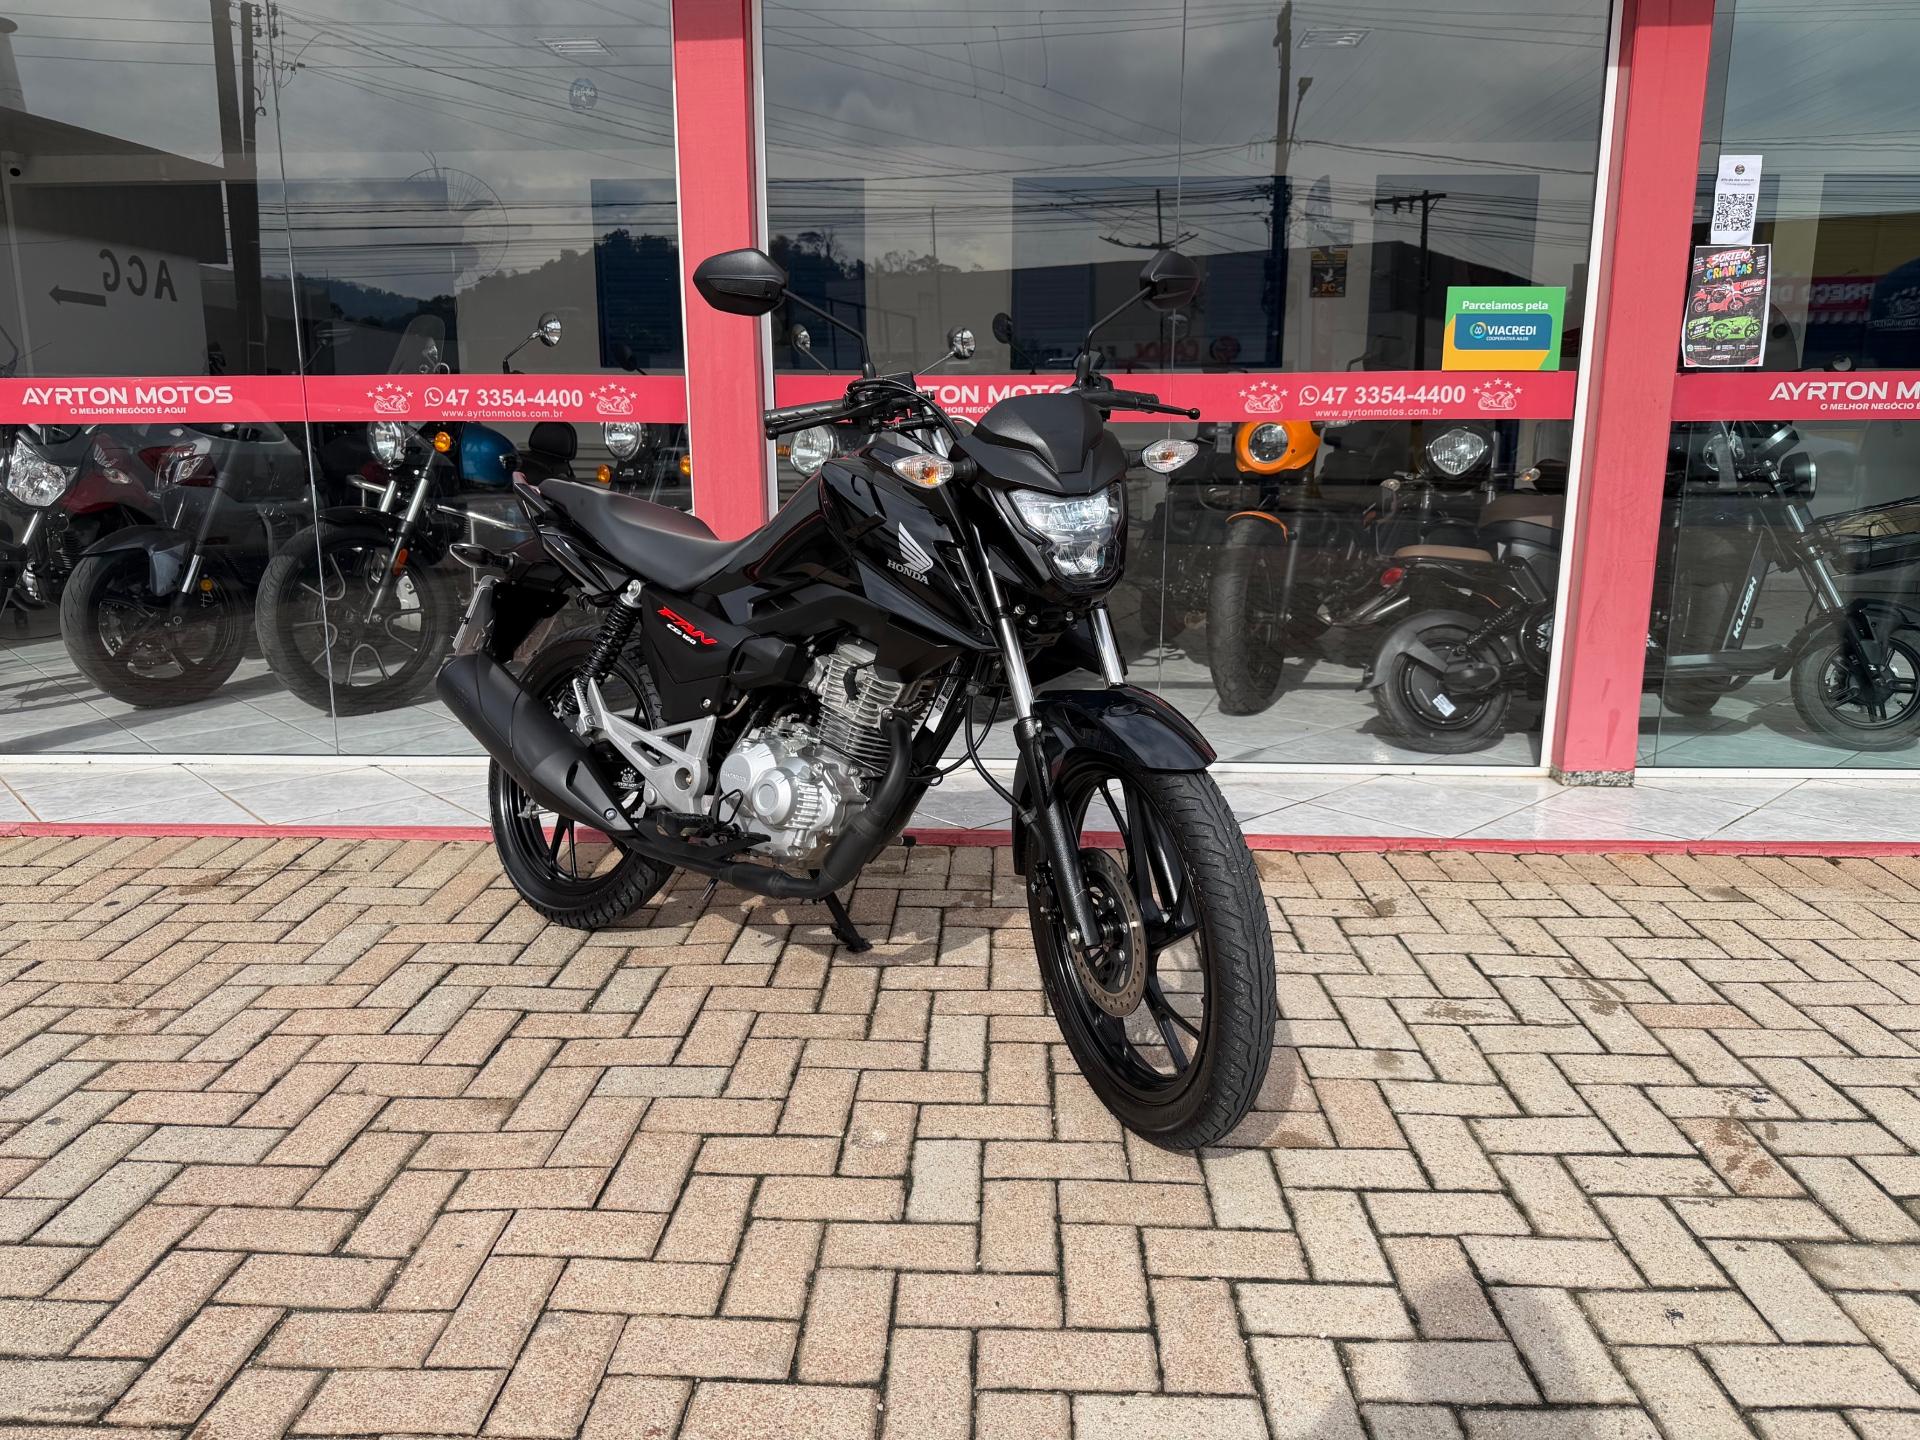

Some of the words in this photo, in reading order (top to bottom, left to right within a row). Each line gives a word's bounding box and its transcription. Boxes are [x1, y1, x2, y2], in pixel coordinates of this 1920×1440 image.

[1711, 250, 1751, 264] SORTEIO
[1706, 263, 1753, 280] CRIANÇAS
[1462, 300, 1524, 310] Parcelamos
[1525, 301, 1549, 312] pela
[1487, 325, 1537, 336] VIACREDI
[21, 387, 129, 405] AYRTON
[135, 385, 234, 404] MOTOS
[445, 389, 470, 407] 47
[476, 388, 584, 407] 3354-4400
[1321, 386, 1348, 405] 47
[1354, 385, 1467, 405] 3354-4400
[1768, 381, 1889, 401] AYRTON
[70, 407, 78, 415] O
[79, 407, 115, 415] MELHOR
[116, 405, 156, 415] NEGÓCIO
[157, 405, 163, 414] É
[164, 406, 187, 415] AQUI
[441, 409, 563, 418] www.ayrtonmotos.com.br
[1315, 407, 1443, 418] www.ayrtonmotos.com.br
[1829, 402, 1870, 411] MELHOR
[1871, 401, 1914, 411] NEGÓCIO
[887, 559, 929, 585] HONDA
[656, 606, 718, 645] FAN
[666, 623, 683, 636] CG
[682, 633, 697, 645] 160
